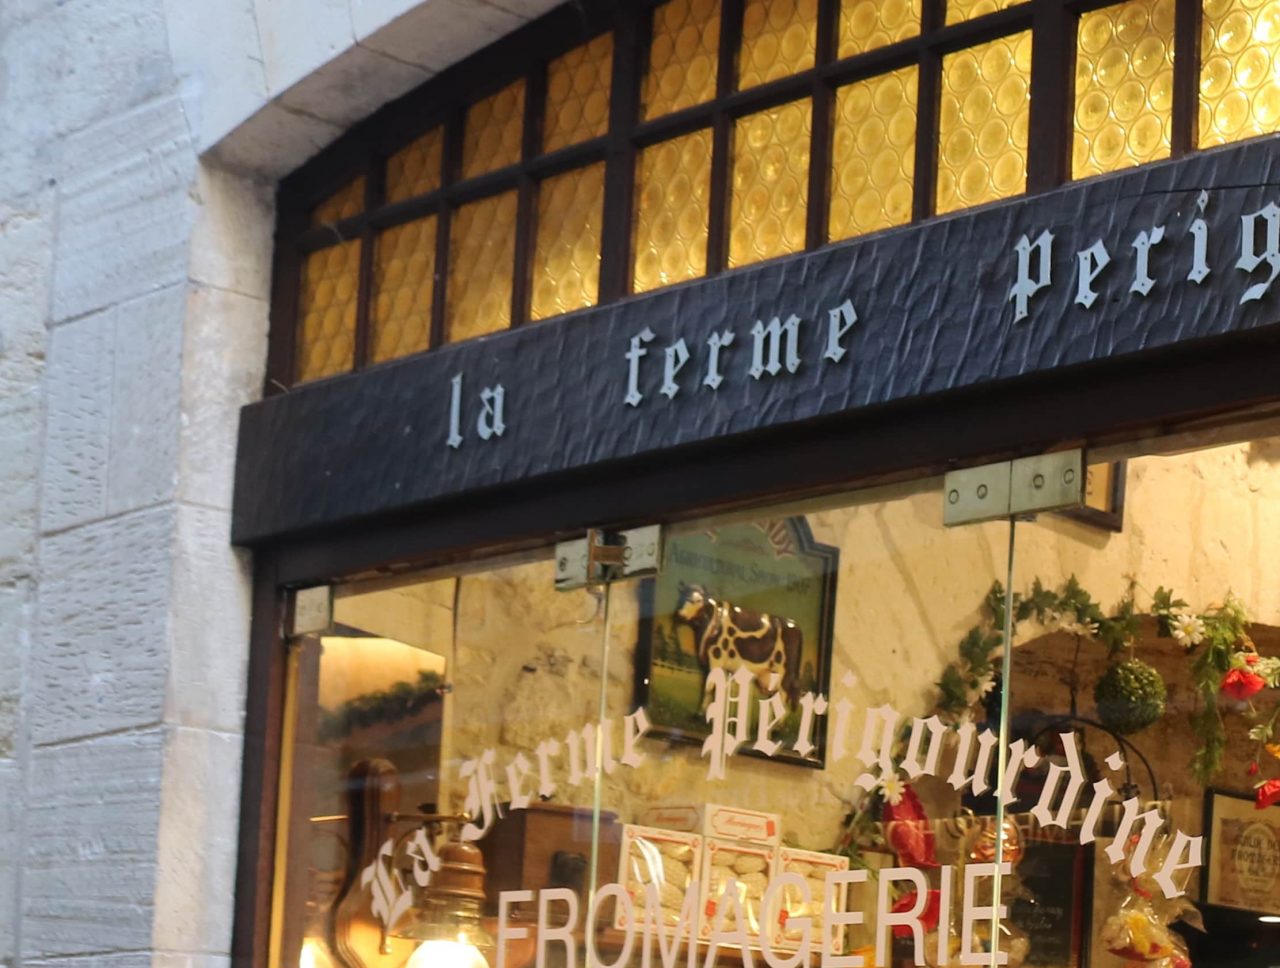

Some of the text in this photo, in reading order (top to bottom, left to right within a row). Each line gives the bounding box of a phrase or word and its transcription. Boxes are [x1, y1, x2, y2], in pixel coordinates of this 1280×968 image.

[446, 372, 507, 449] la
[623, 299, 858, 407] ferme
[361, 666, 1204, 932] La Ferme Périgourdine
